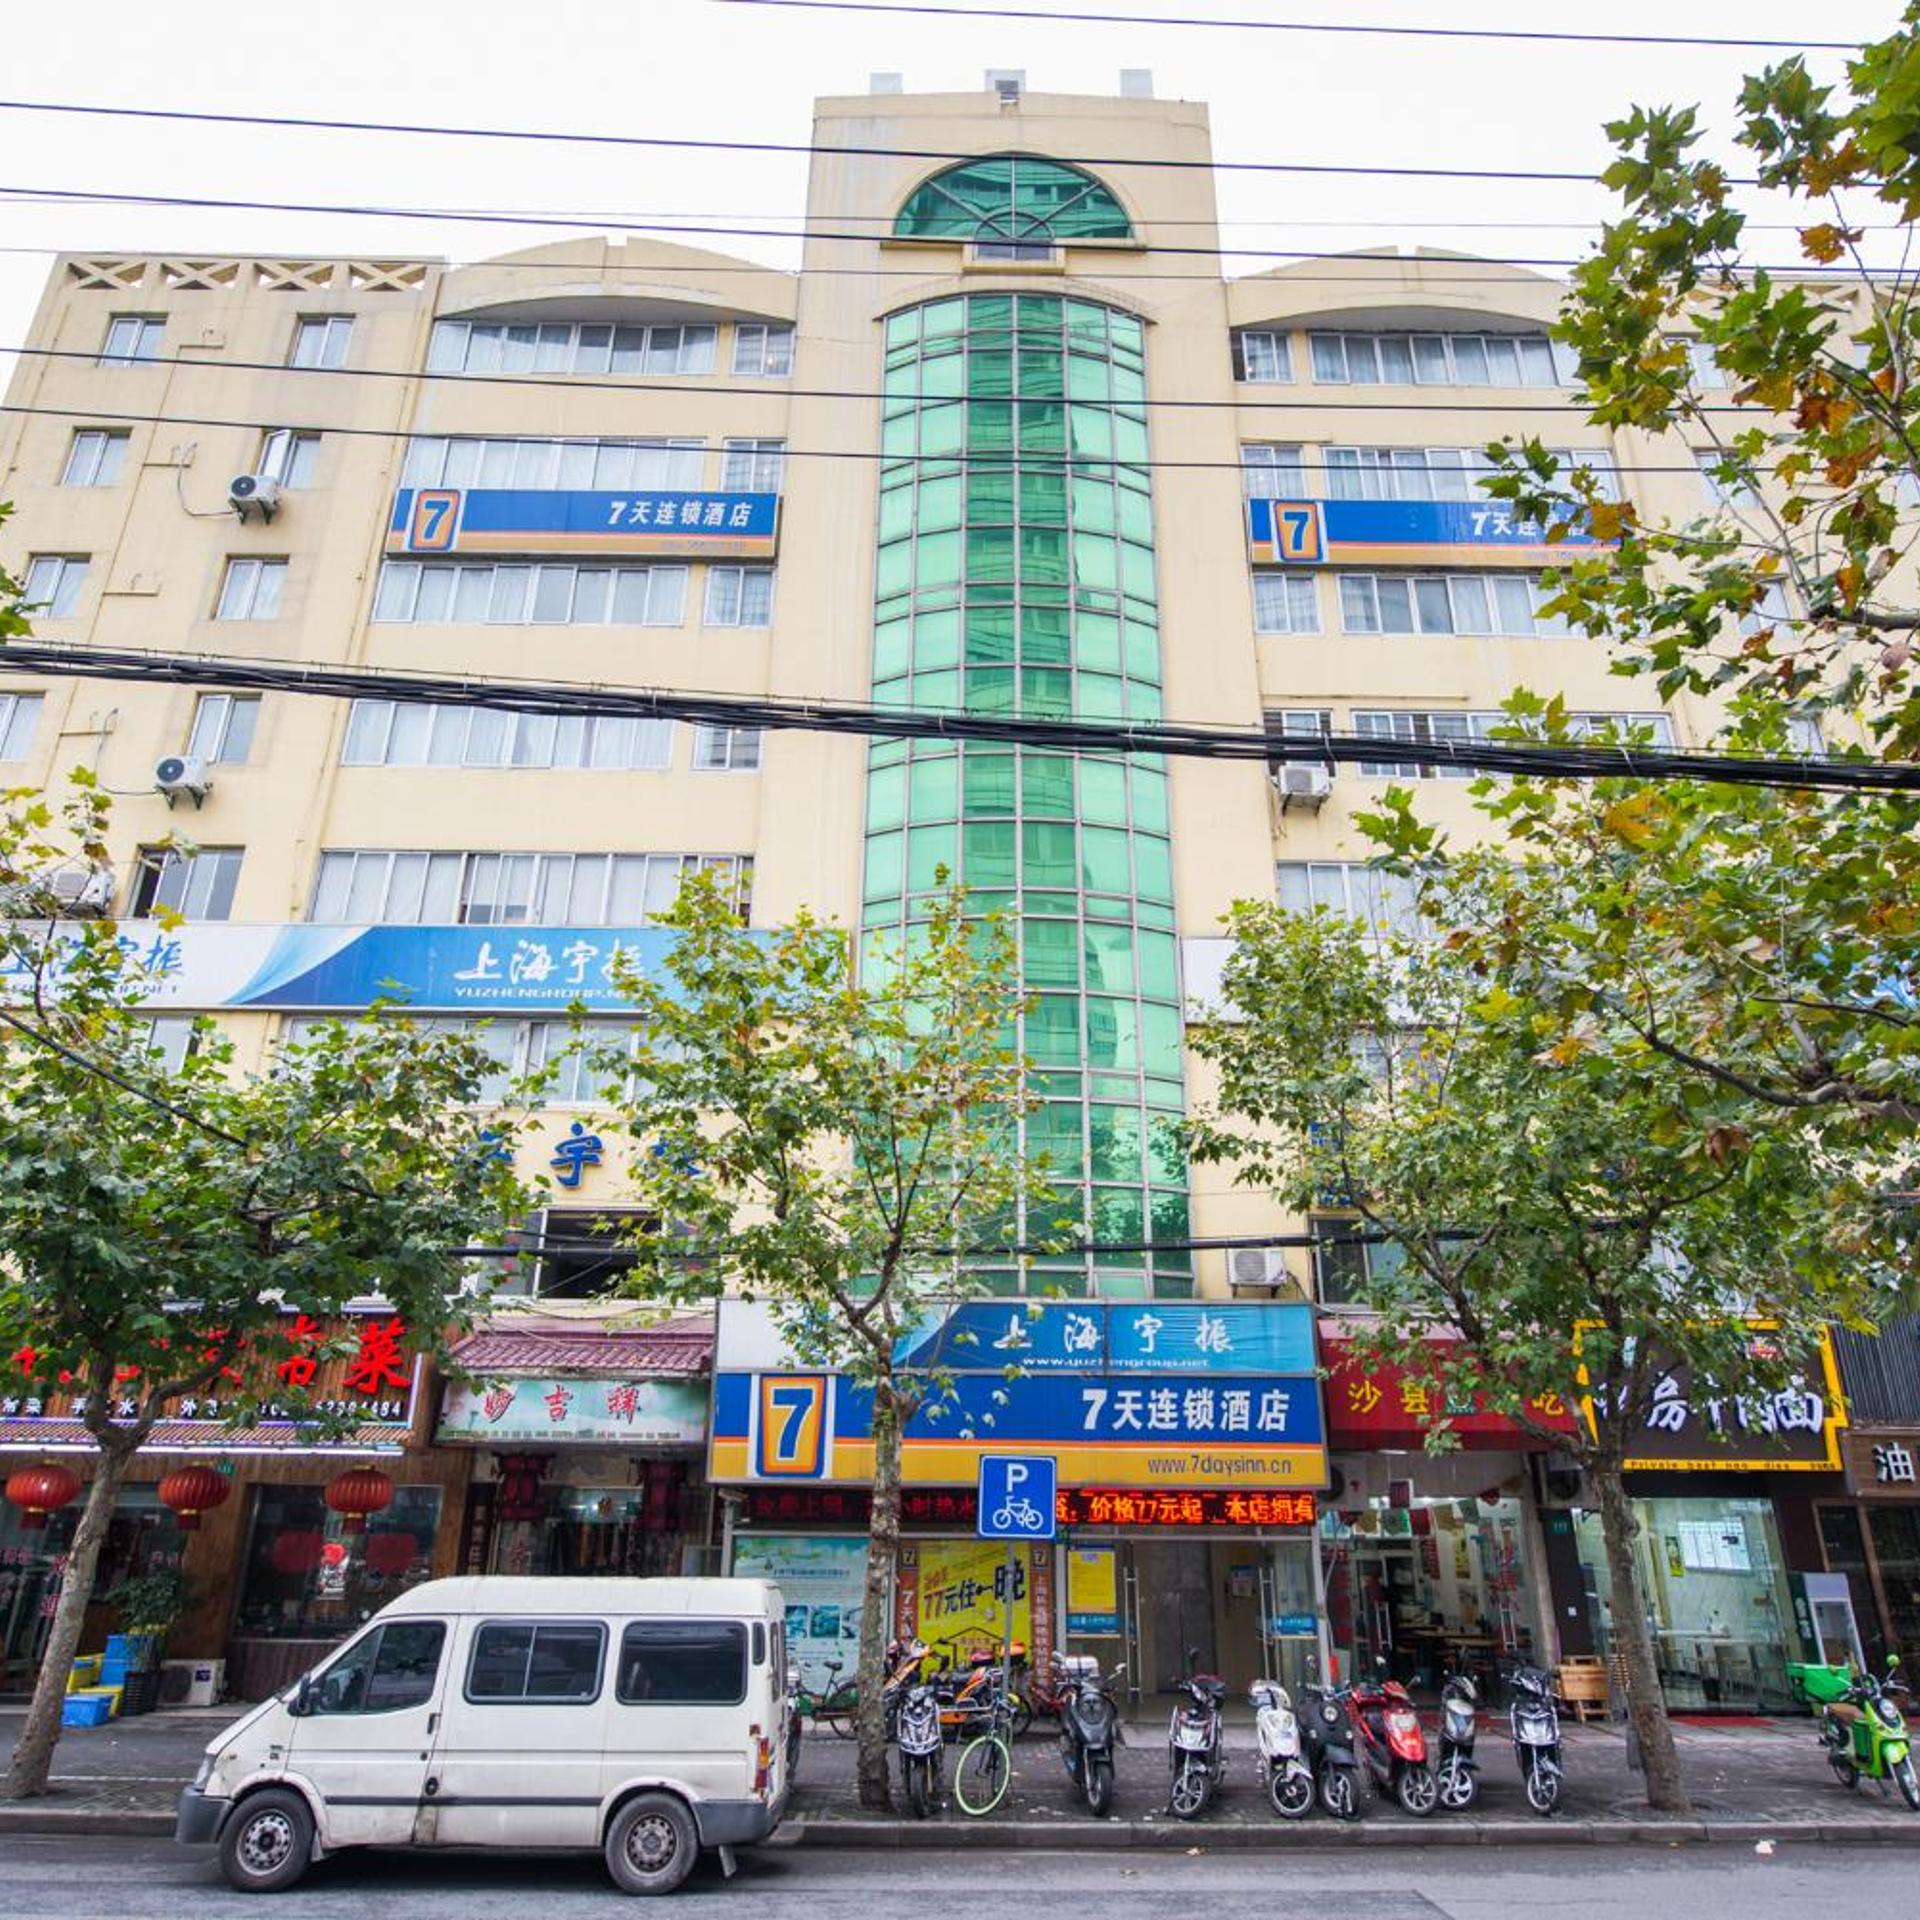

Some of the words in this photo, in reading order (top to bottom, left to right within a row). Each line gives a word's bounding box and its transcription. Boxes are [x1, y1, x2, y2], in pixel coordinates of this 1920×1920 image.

[421, 497, 451, 542] 7
[608, 500, 753, 527] 7天连锁酒店
[1282, 509, 1310, 552] 7
[992, 1313, 1234, 1353] 上海宇振
[770, 1387, 816, 1461] 7
[1082, 1388, 1290, 1431] 7天连锁酒店
[1006, 1463, 1029, 1492] P
[1147, 1454, 1293, 1476] www.7daysinn.cn
[1873, 1441, 1915, 1482] 油
